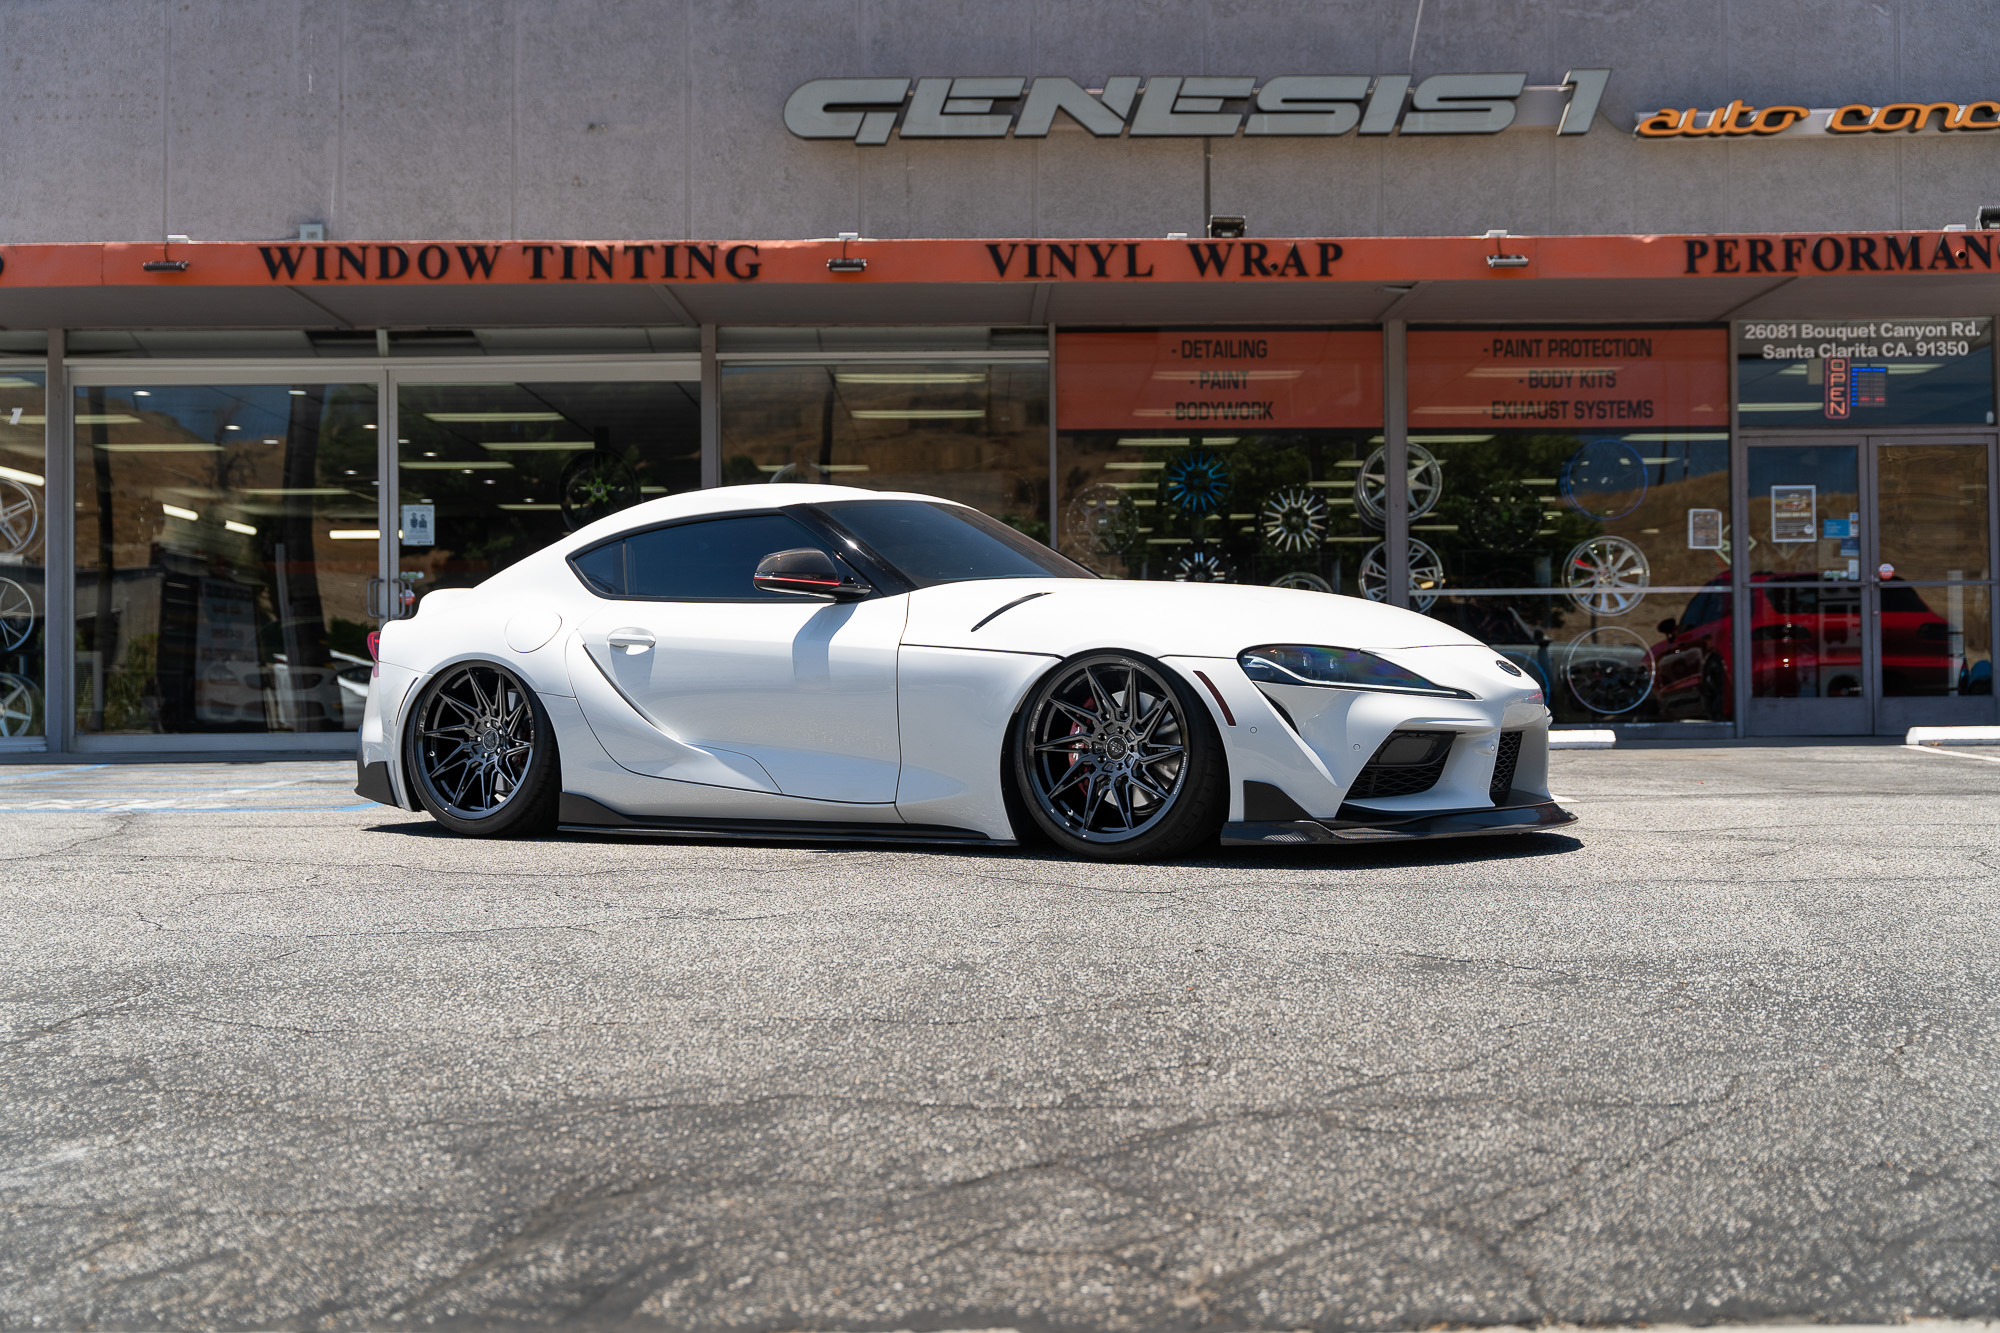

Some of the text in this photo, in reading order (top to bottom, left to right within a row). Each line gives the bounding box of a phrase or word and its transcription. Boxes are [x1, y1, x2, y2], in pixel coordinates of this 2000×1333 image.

[782, 67, 1612, 145] GENESIS 1
[1636, 98, 1811, 138] auto
[258, 244, 763, 281] WINDOW TINTING
[984, 242, 1344, 278] VINYL WRAP
[1683, 234, 2000, 273] PERFORMAN
[1744, 320, 1981, 342] 26081 Bouquet Canyon Rd.
[1181, 339, 1268, 359] DETAILING
[1492, 338, 1653, 358] PAINT PROTECTION
[1762, 340, 1969, 360] Santa Clarita CA. 91350
[1200, 370, 1250, 390] PAINT
[1528, 369, 1617, 389] BODY KITS
[1829, 358, 1846, 416] OPEN
[1175, 401, 1274, 421] BODYWORK
[1491, 399, 1654, 420] EXHAUST SYSTEMS
